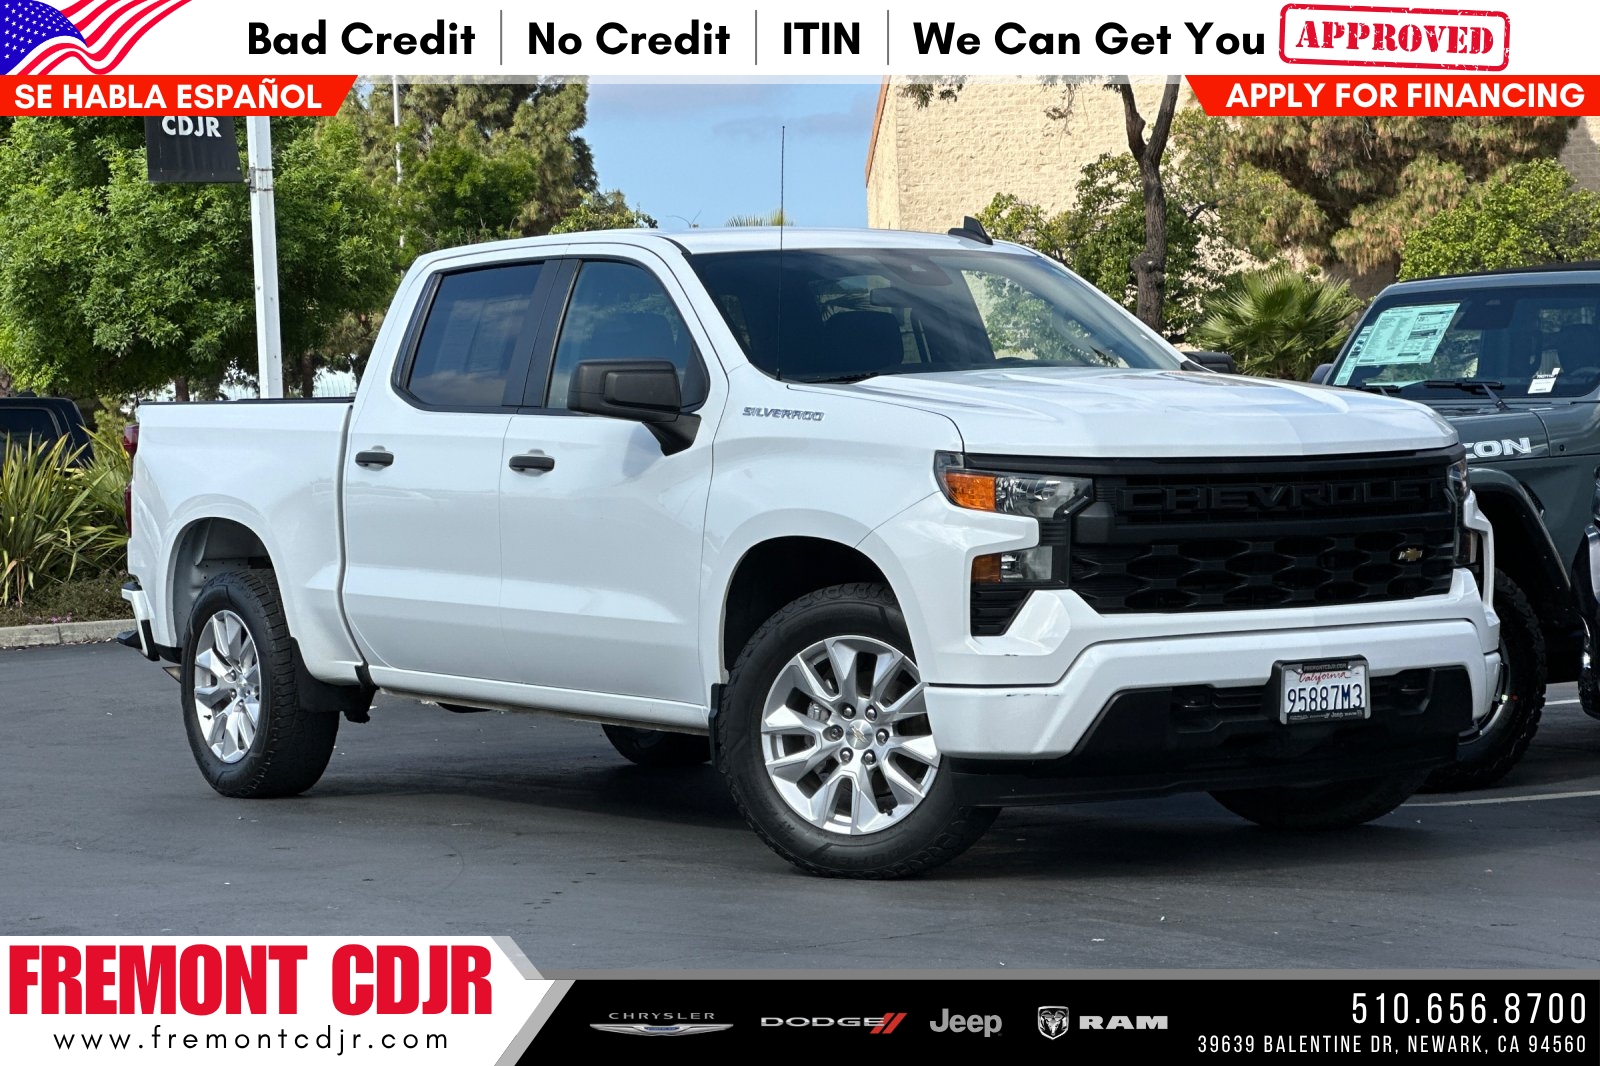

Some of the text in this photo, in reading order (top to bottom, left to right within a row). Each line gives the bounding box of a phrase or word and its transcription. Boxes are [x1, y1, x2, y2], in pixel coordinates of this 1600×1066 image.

[161, 115, 222, 138] CDJR
[742, 406, 825, 421] SILVERADO
[1116, 477, 1446, 513] CHEVROLET
[1287, 683, 1363, 713] 95887M3
